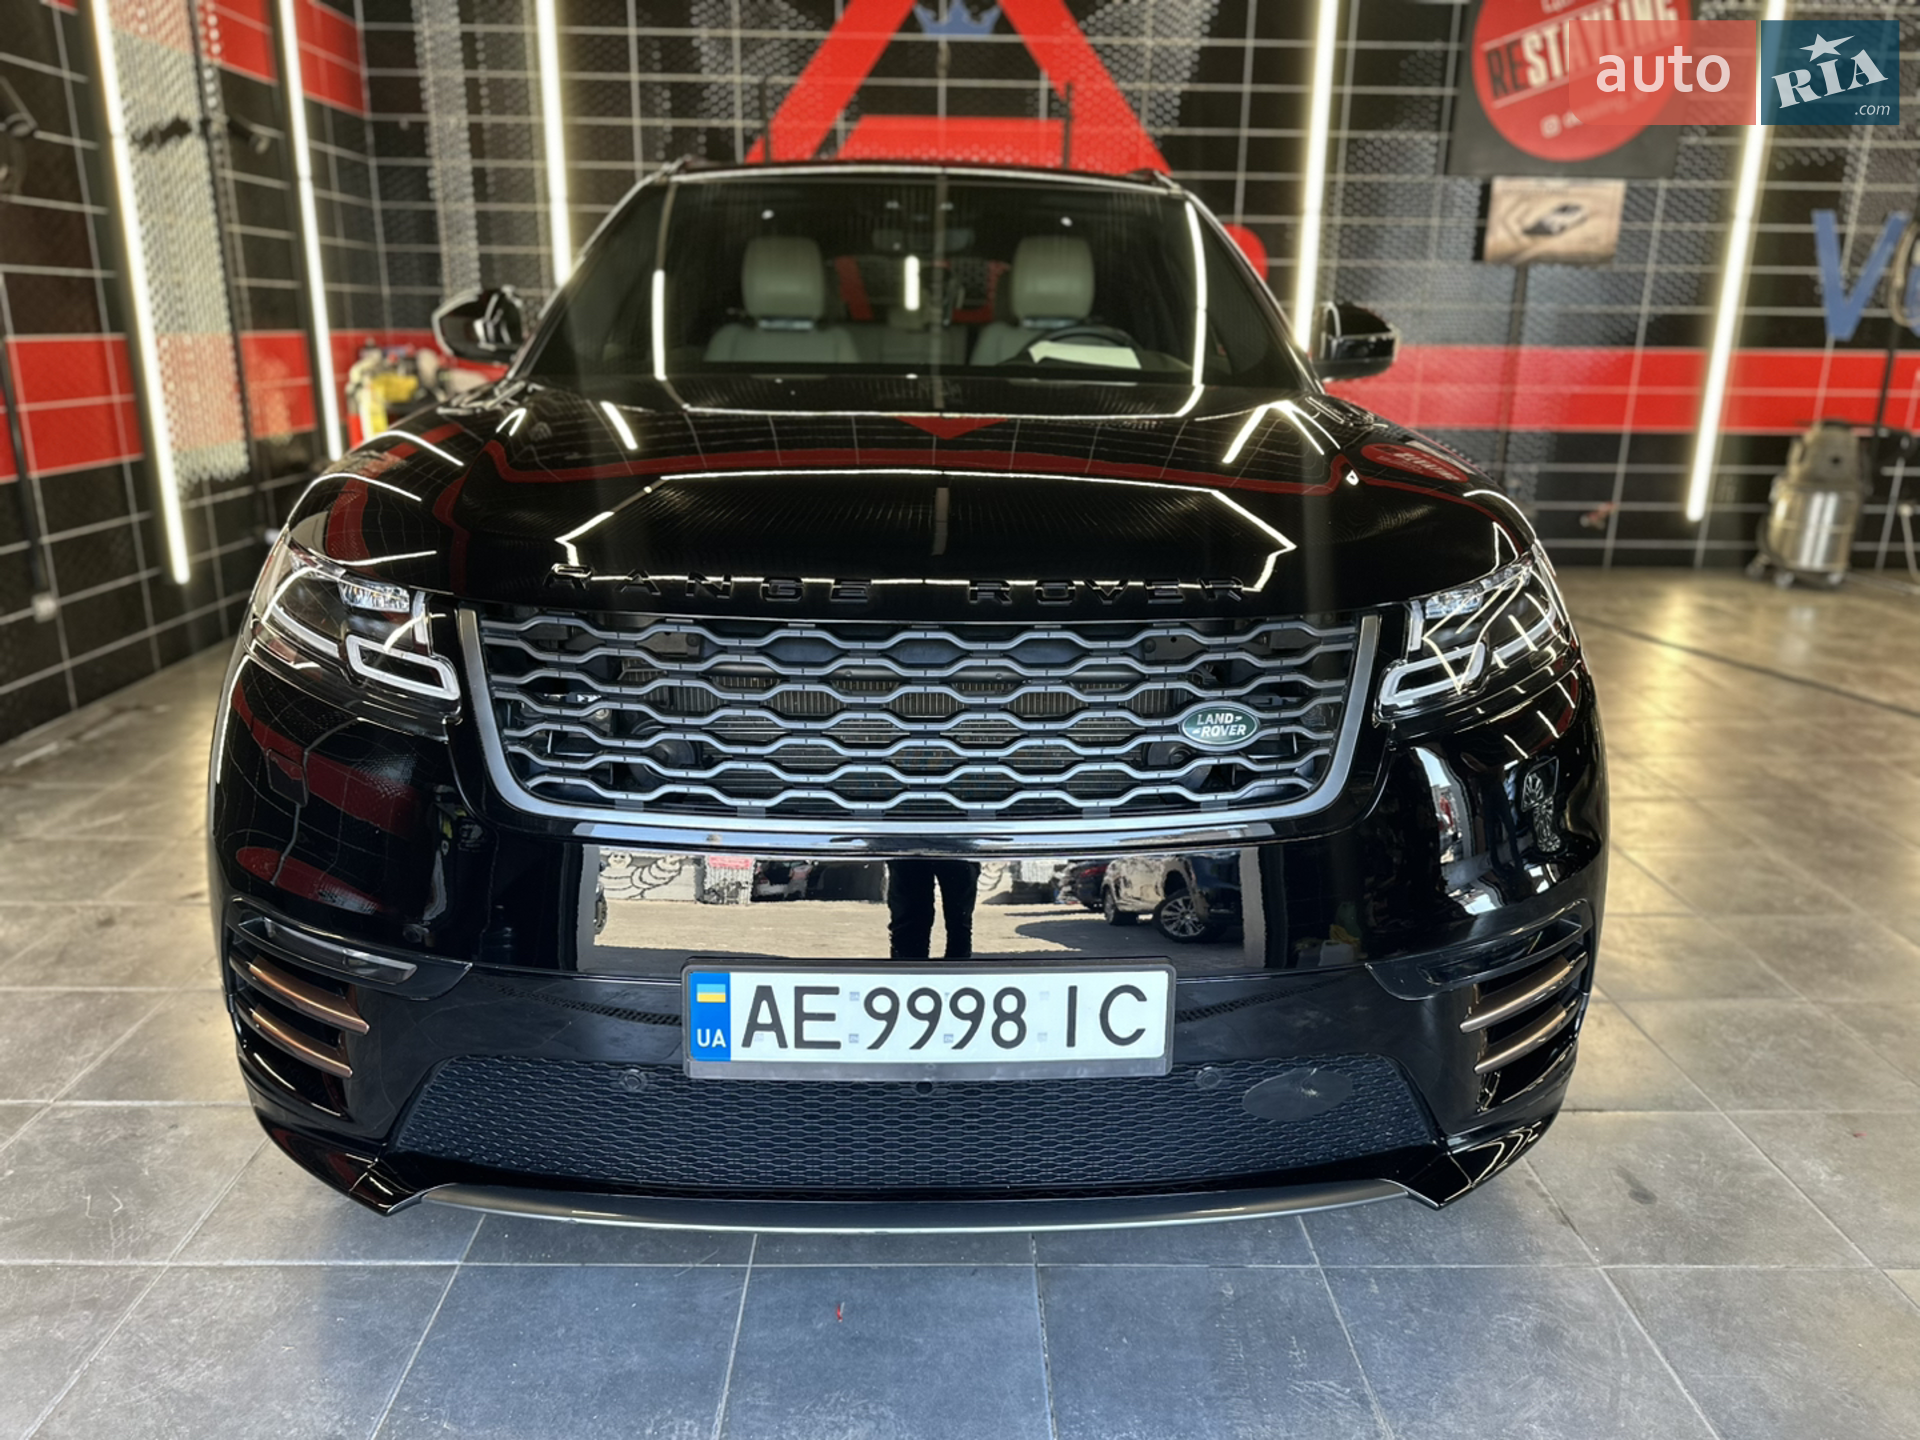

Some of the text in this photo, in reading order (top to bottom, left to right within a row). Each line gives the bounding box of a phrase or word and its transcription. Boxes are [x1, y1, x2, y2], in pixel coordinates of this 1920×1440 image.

[543, 562, 1243, 604] RANGE ROVER
[1197, 713, 1234, 725] LAND
[1201, 724, 1246, 737] ROVER
[741, 984, 1147, 1050] AE 9998 IC
[697, 1029, 726, 1048] UA
